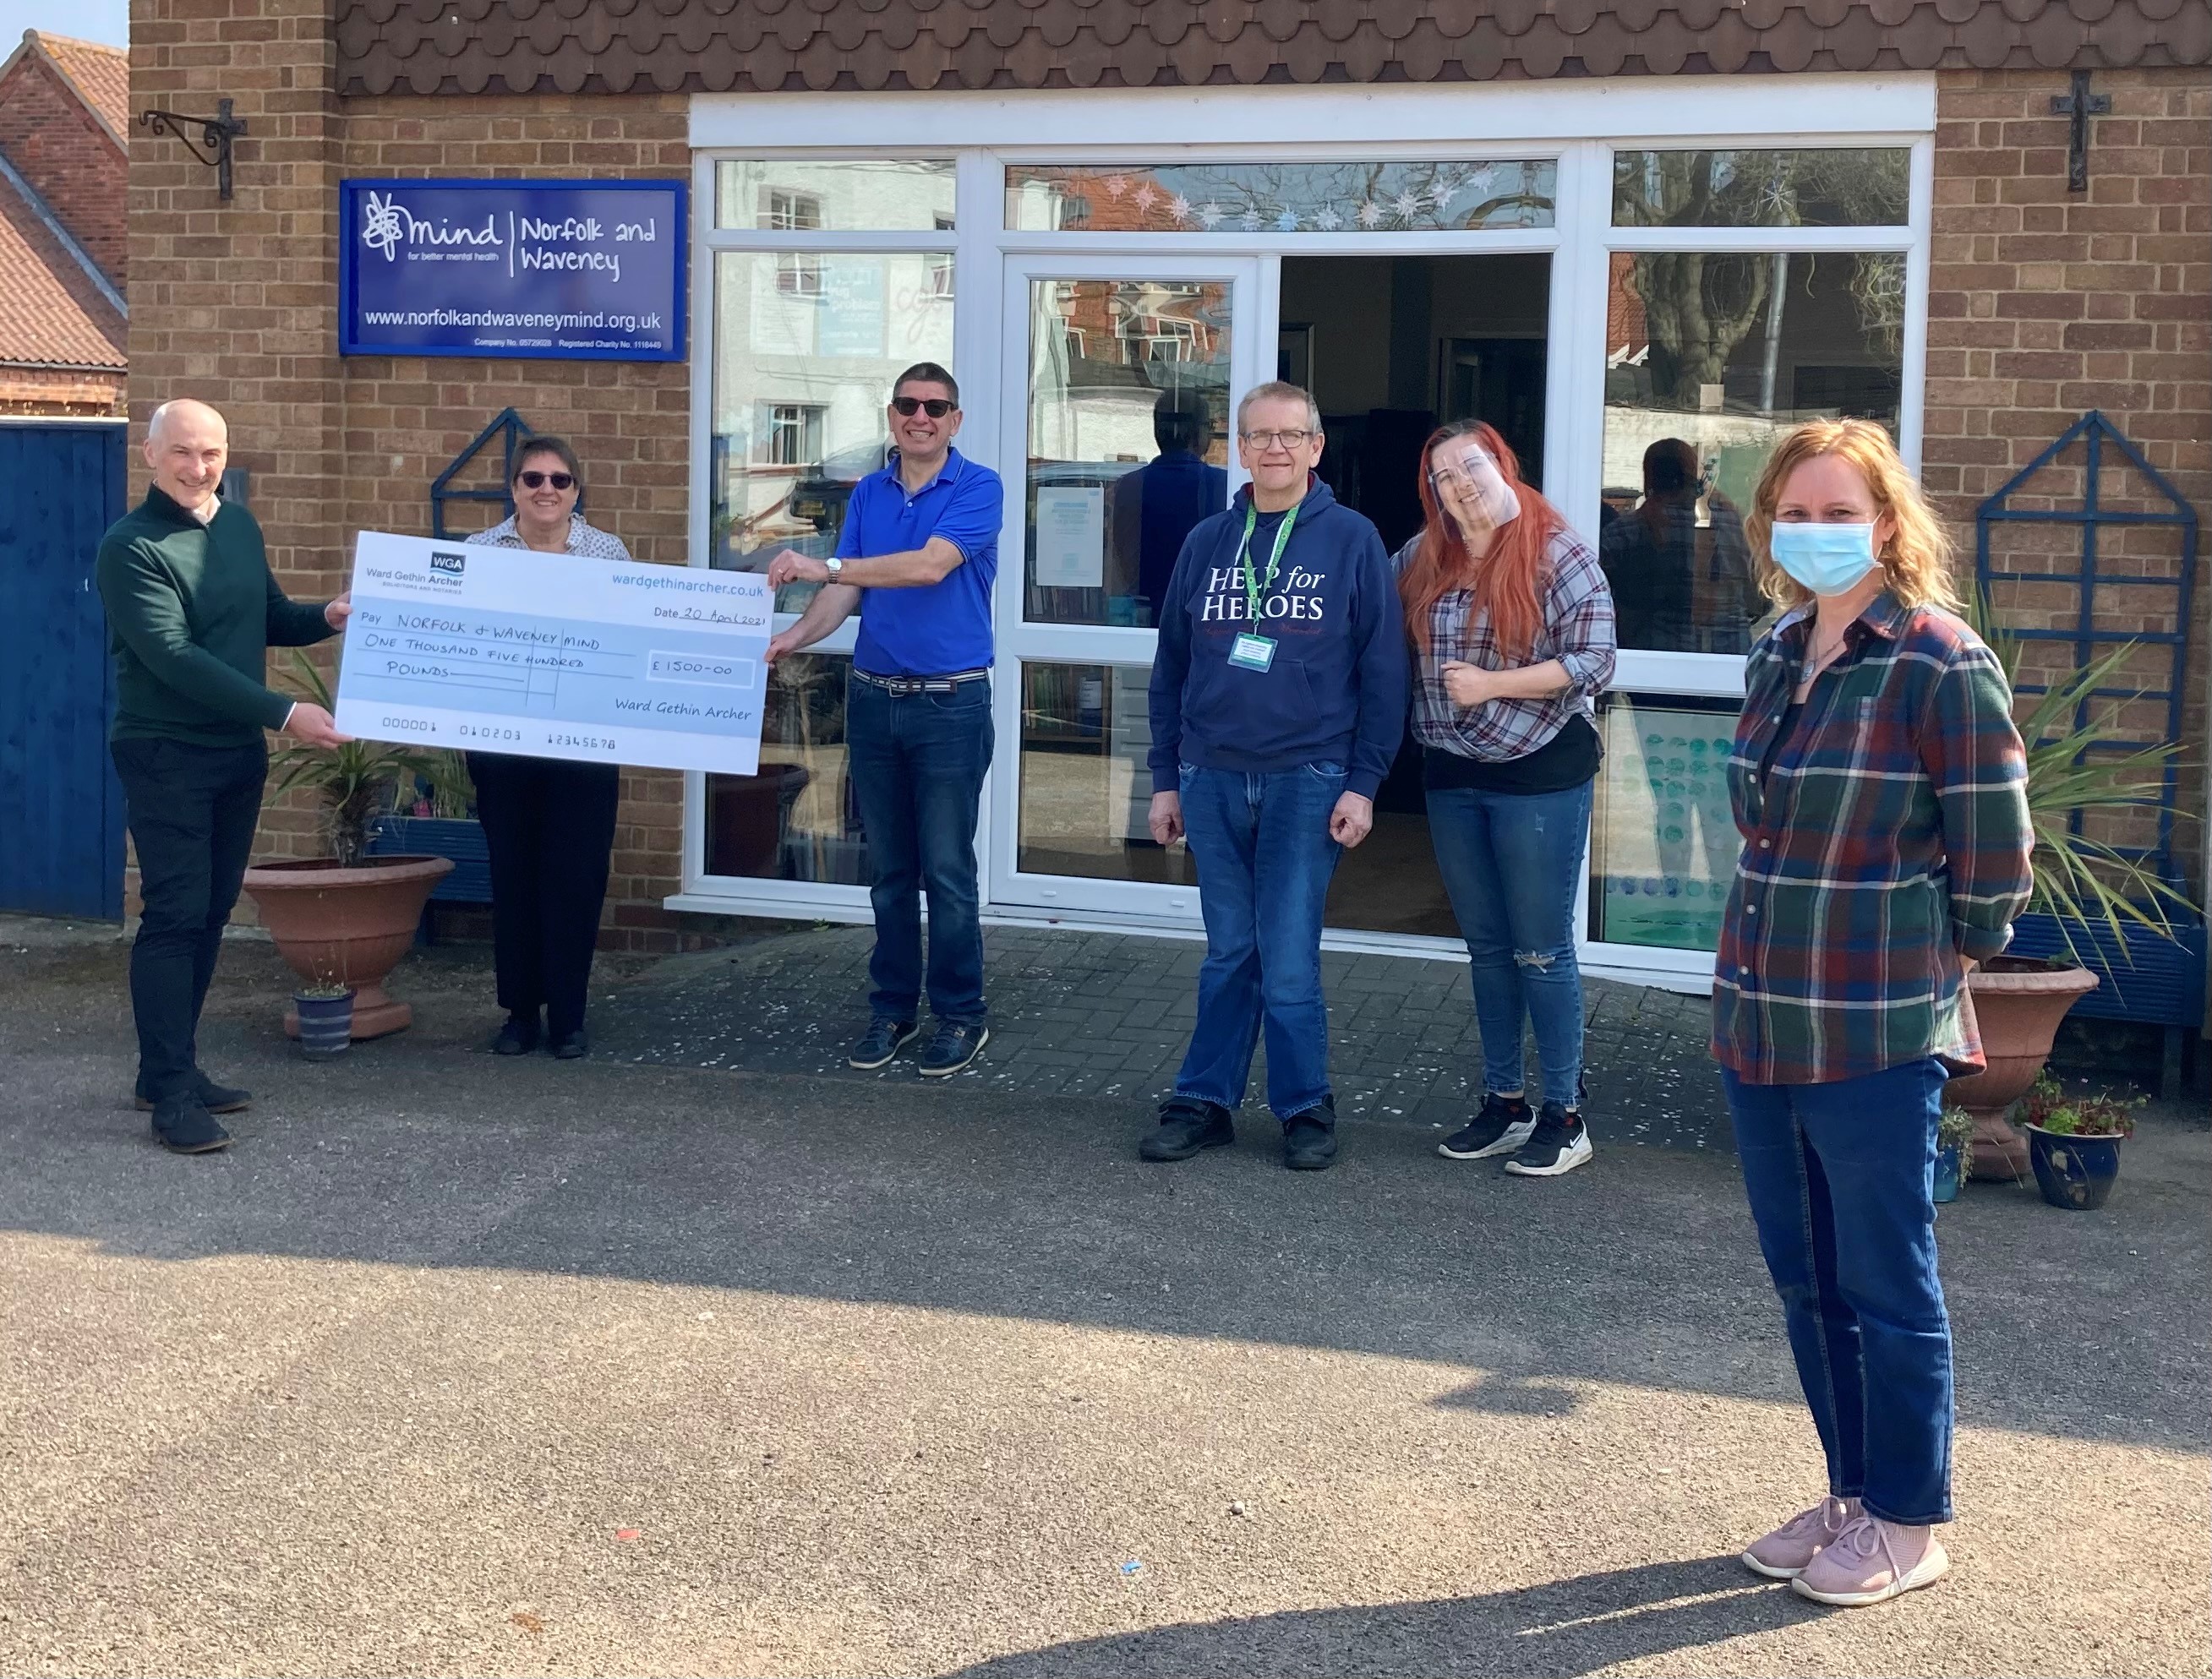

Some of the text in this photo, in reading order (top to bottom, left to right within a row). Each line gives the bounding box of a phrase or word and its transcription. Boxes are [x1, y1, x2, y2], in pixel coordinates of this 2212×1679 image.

[407, 214, 504, 245] mind
[521, 217, 655, 243] Norfolk and
[407, 252, 500, 261] for better mental health
[521, 247, 620, 282] Waveney
[365, 308, 662, 332] www.norfolkandwaveneymind.org.uk
[474, 337, 505, 348] Company
[507, 338, 518, 346] No.
[559, 339, 594, 349] Registered
[596, 340, 620, 350] Charity
[434, 557, 462, 570] WGA
[367, 568, 463, 587] Ward Gethin Archer
[612, 574, 763, 597] wardgethinarcher.co.uk
[1206, 565, 1325, 594] HELP for
[653, 607, 766, 627] Date 20 April 2021
[1201, 594, 1324, 621] HEROES
[362, 612, 381, 624] Pay
[398, 614, 466, 633] NORFOLK
[494, 627, 558, 644] WAVENEY
[564, 636, 600, 651] MIND
[364, 633, 584, 668] ONE THOUSAND FIVE HUNDRED
[387, 661, 449, 677] POUNDS
[615, 698, 751, 720] Ward Gethin Archer
[382, 717, 615, 750] 000001 010203 12345678
